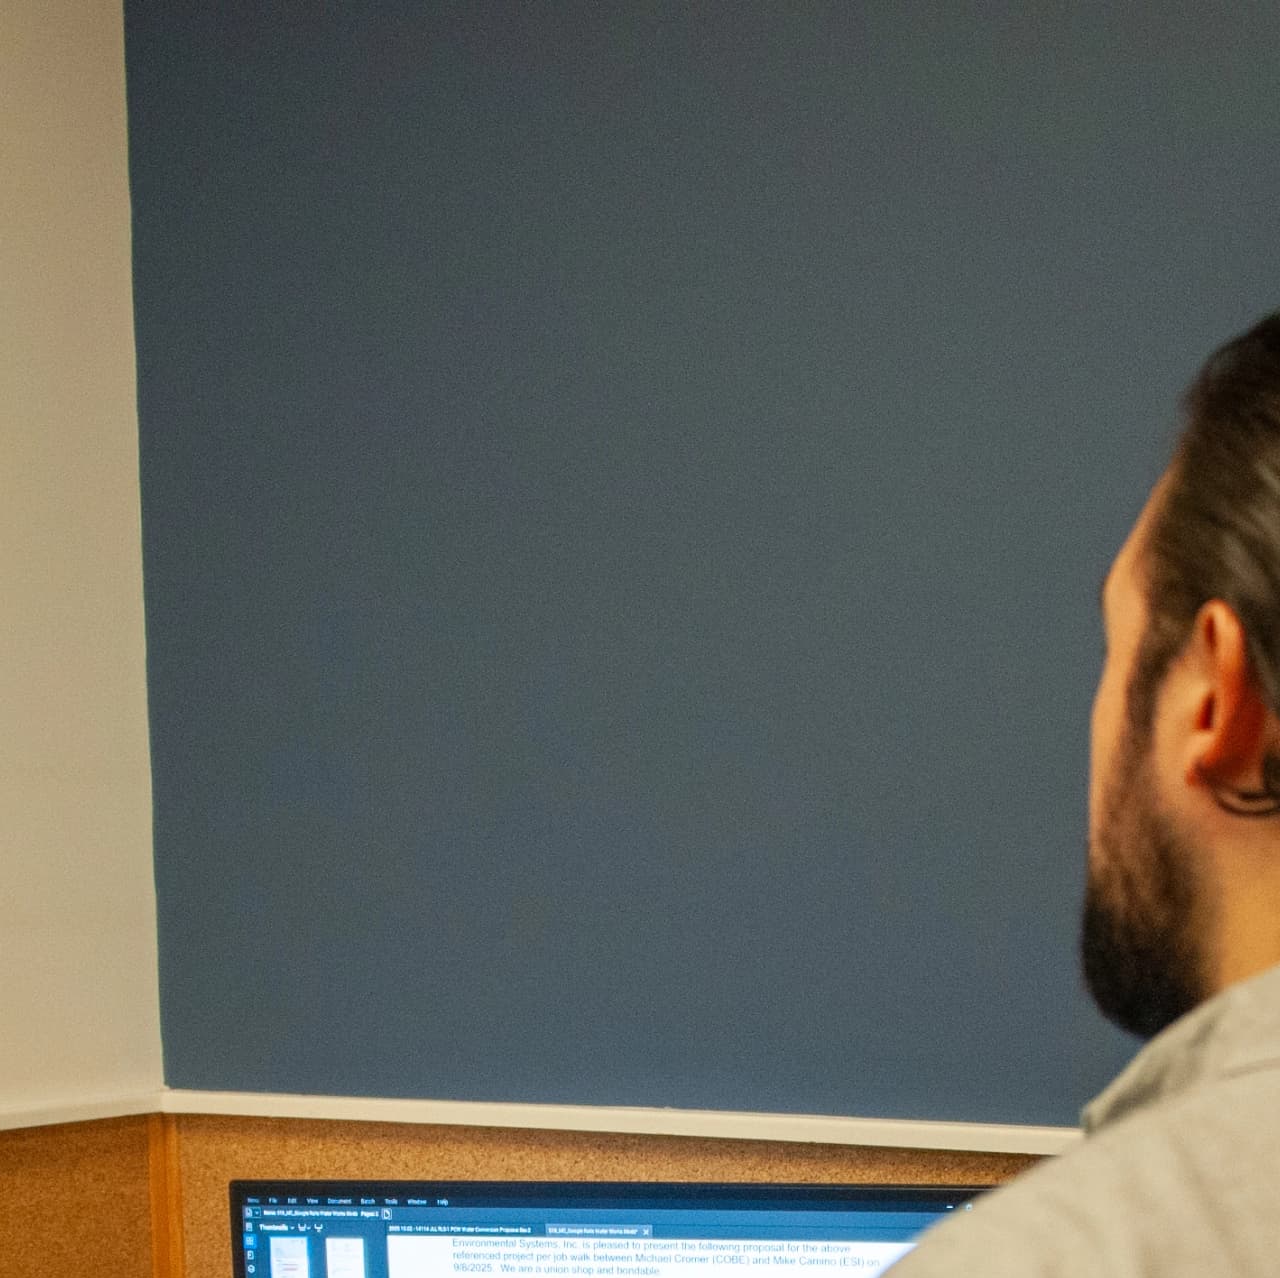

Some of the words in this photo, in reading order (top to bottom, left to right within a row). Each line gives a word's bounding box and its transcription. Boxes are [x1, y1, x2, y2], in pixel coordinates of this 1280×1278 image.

[452, 1238, 516, 1248] Environmental
[593, 1240, 630, 1251] pleased
[643, 1241, 678, 1252] present
[681, 1241, 695, 1250] the
[698, 1241, 740, 1252] following
[742, 1241, 784, 1253] proposal
[787, 1242, 798, 1251] for
[802, 1242, 817, 1251] the
[452, 1250, 500, 1260] referenced
[502, 1251, 534, 1262] project
[536, 1253, 550, 1263] per
[553, 1252, 567, 1263] job
[570, 1252, 590, 1261] walk
[593, 1252, 632, 1262] between
[634, 1253, 671, 1263] Michael
[752, 1255, 770, 1264] and
[773, 1255, 795, 1265] Mike
[500, 1263, 515, 1272] We
[518, 1265, 533, 1273] are
[543, 1264, 570, 1273] union
[571, 1264, 594, 1276] shop
[596, 1264, 613, 1274] and
